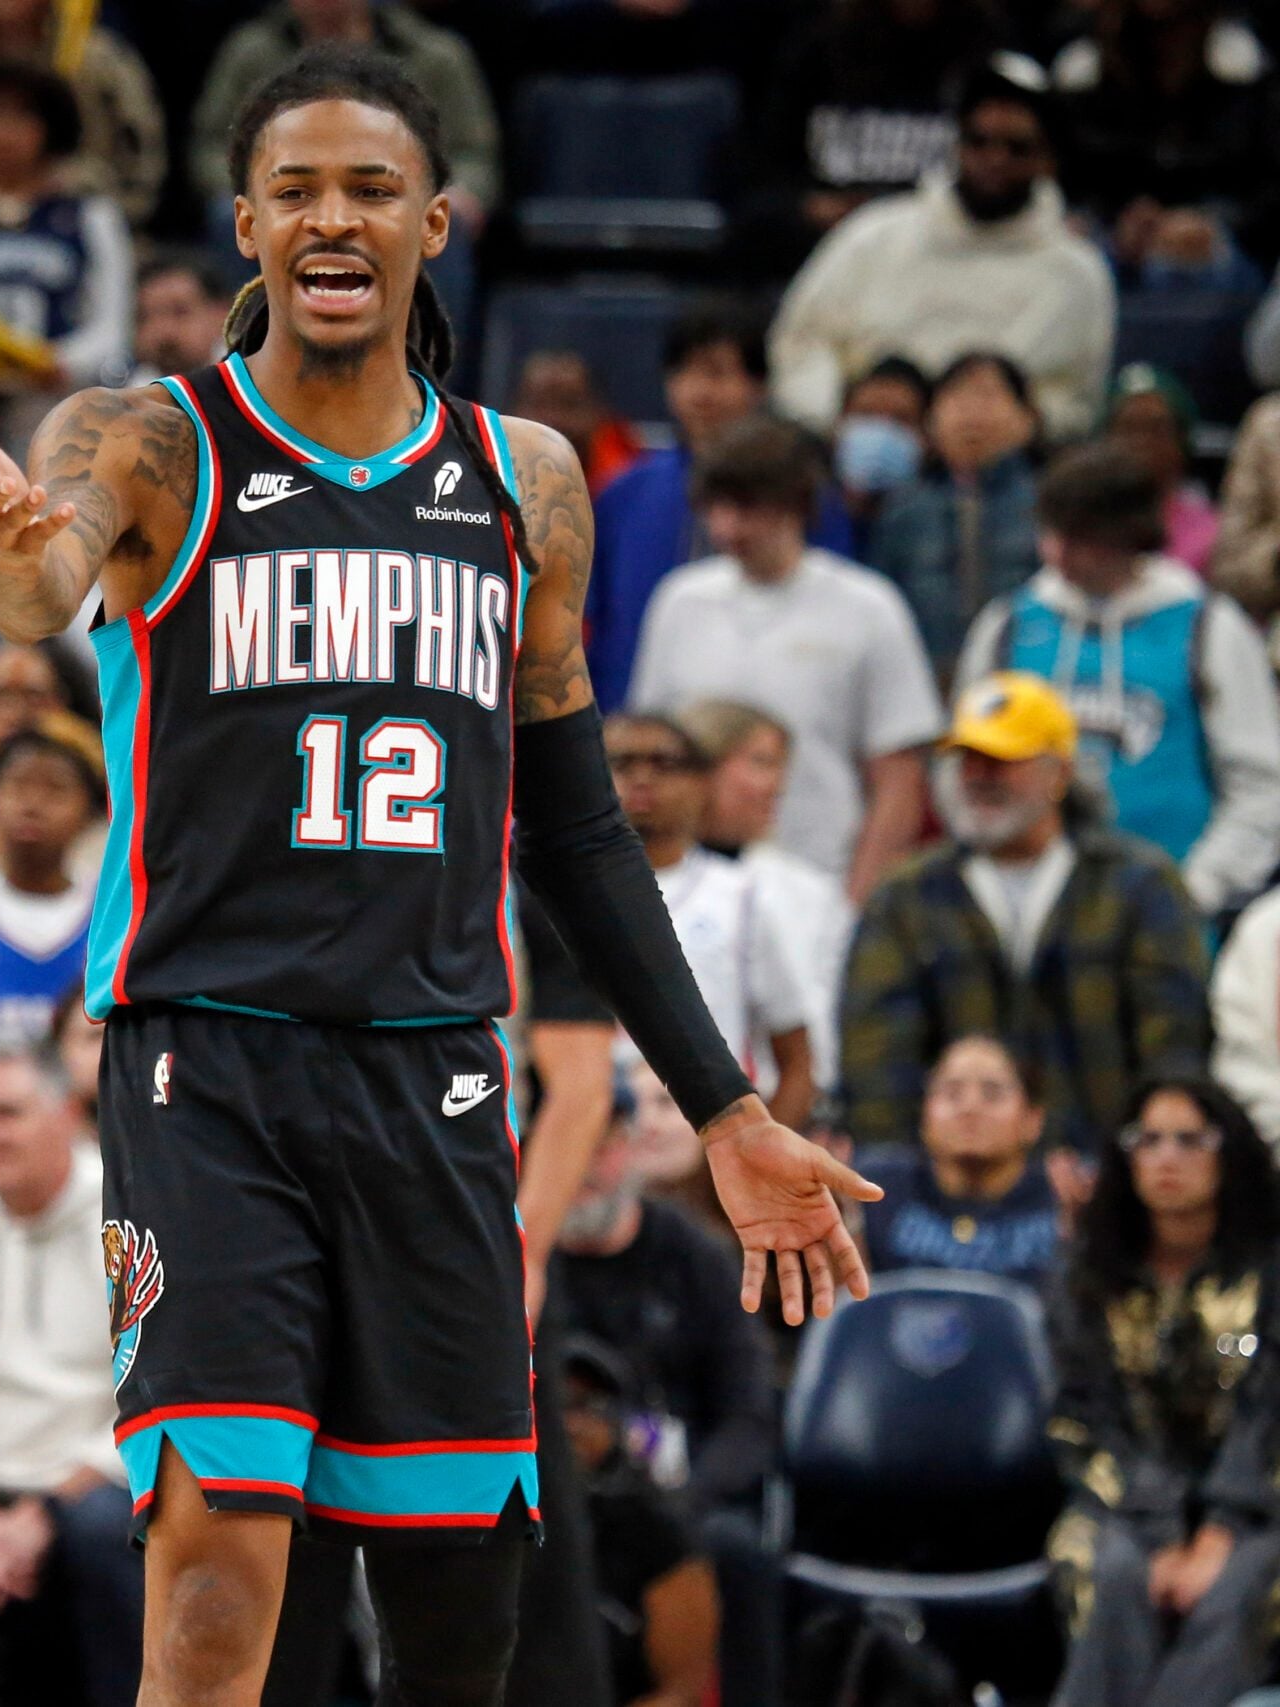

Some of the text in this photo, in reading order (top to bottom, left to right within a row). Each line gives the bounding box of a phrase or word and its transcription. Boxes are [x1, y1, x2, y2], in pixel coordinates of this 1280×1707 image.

[246, 473, 295, 497] NIKE
[415, 506, 492, 526] Robinhood
[209, 548, 510, 711] MEMPHIS
[290, 713, 448, 854] 12
[450, 1073, 489, 1100] NIKE
